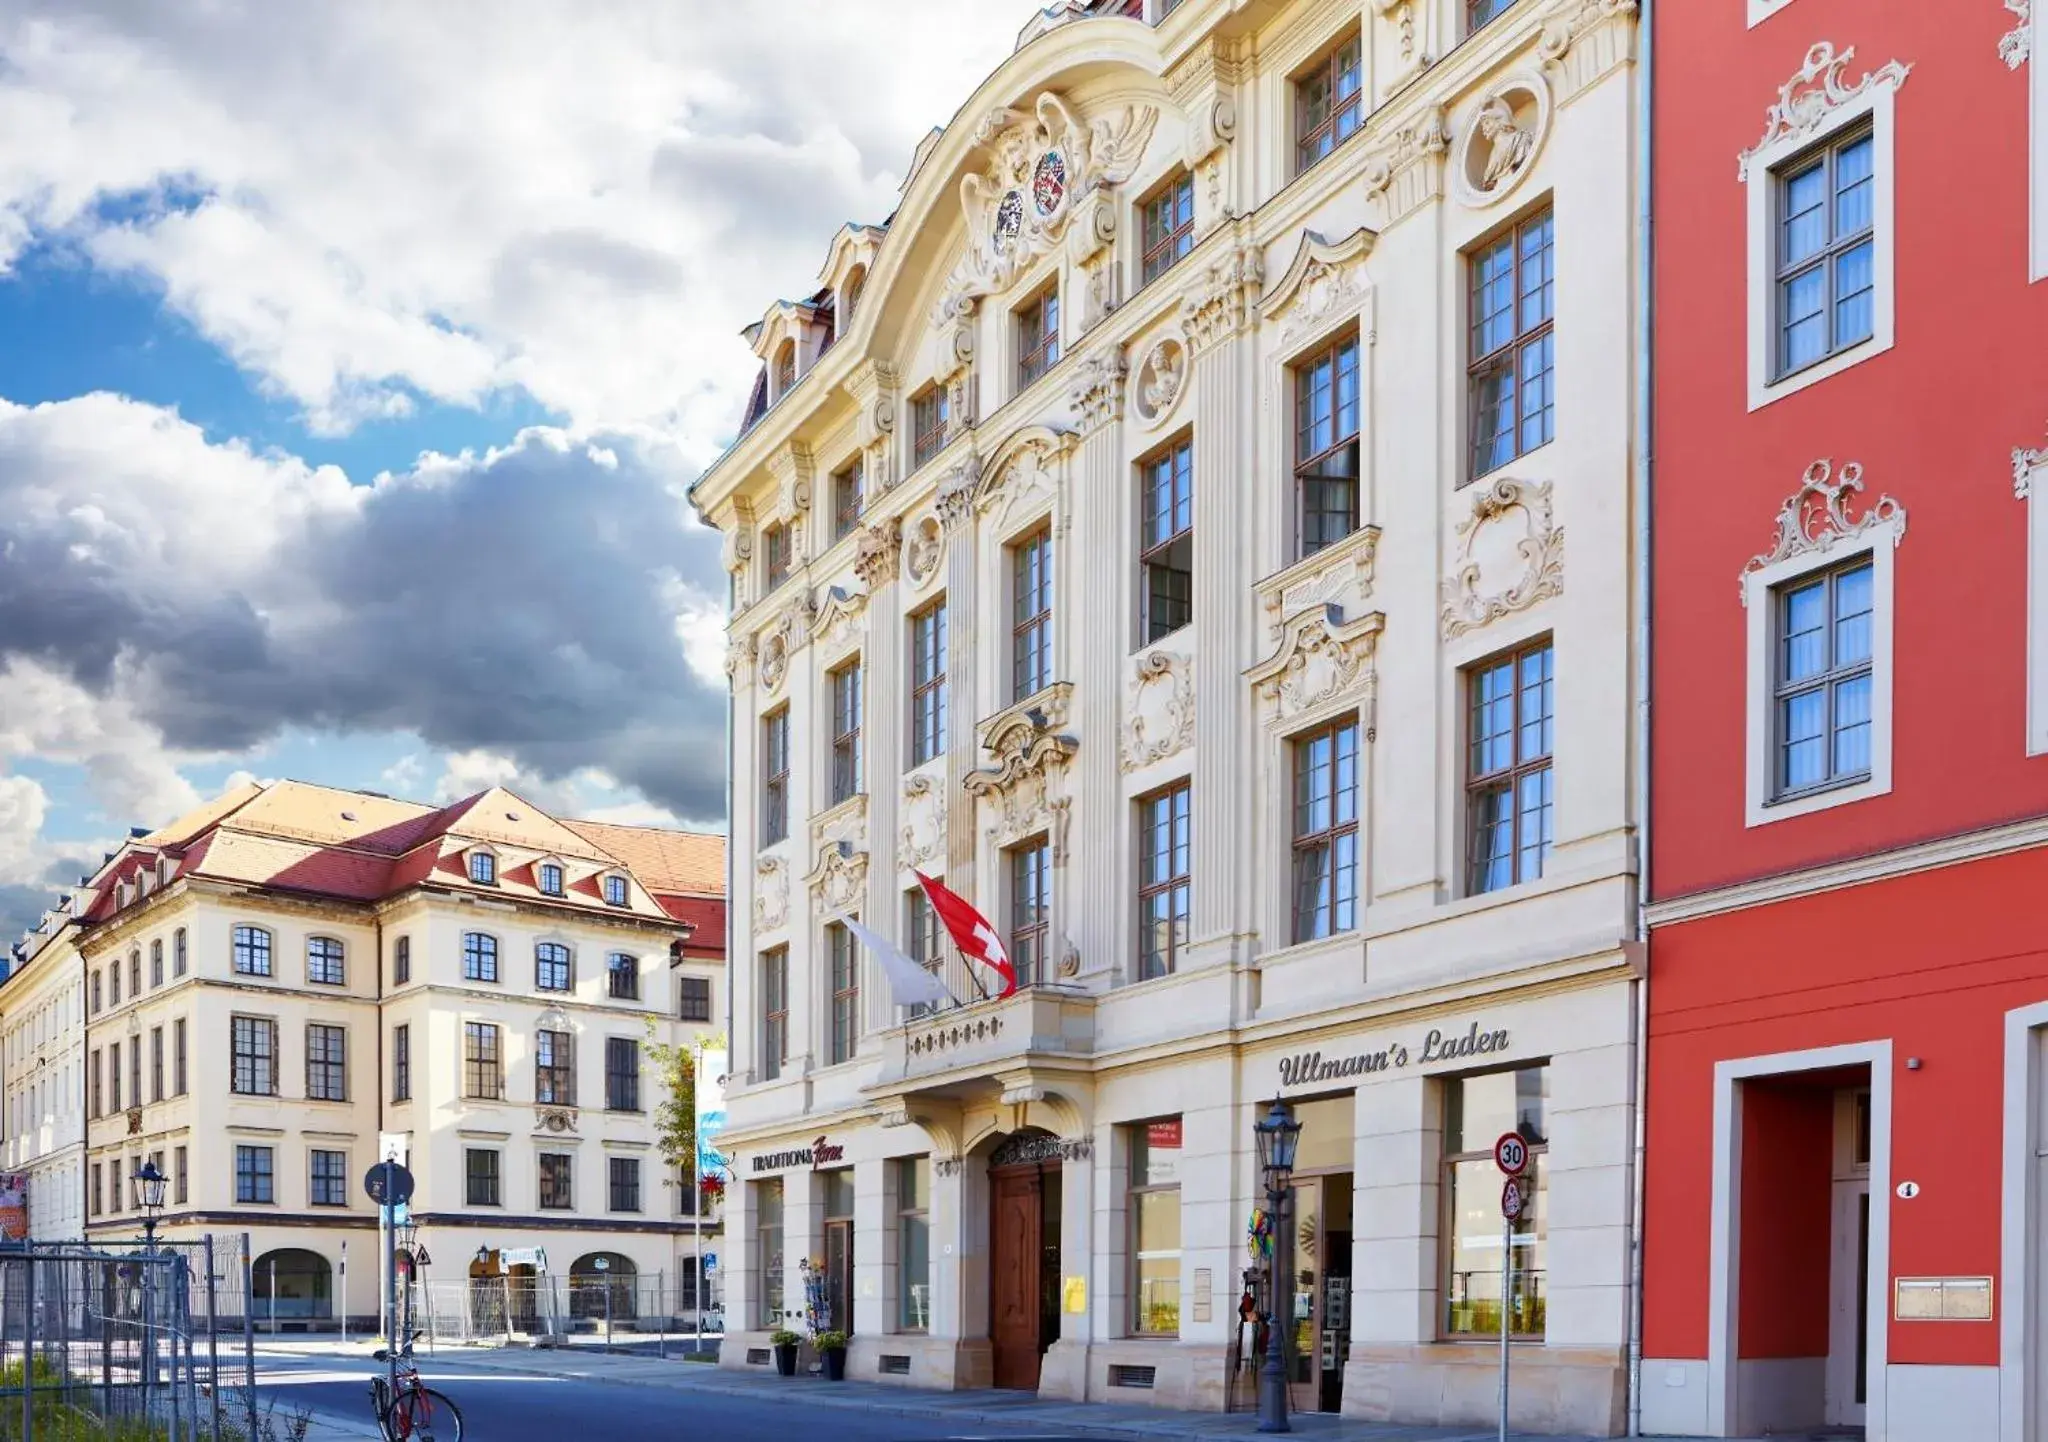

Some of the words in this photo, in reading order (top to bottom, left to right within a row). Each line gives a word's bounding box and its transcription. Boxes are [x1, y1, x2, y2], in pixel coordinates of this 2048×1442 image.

[1279, 1043, 1408, 1087] Ullmann's
[1418, 1021, 1510, 1064] Laden
[1502, 1144, 1522, 1164] 30
